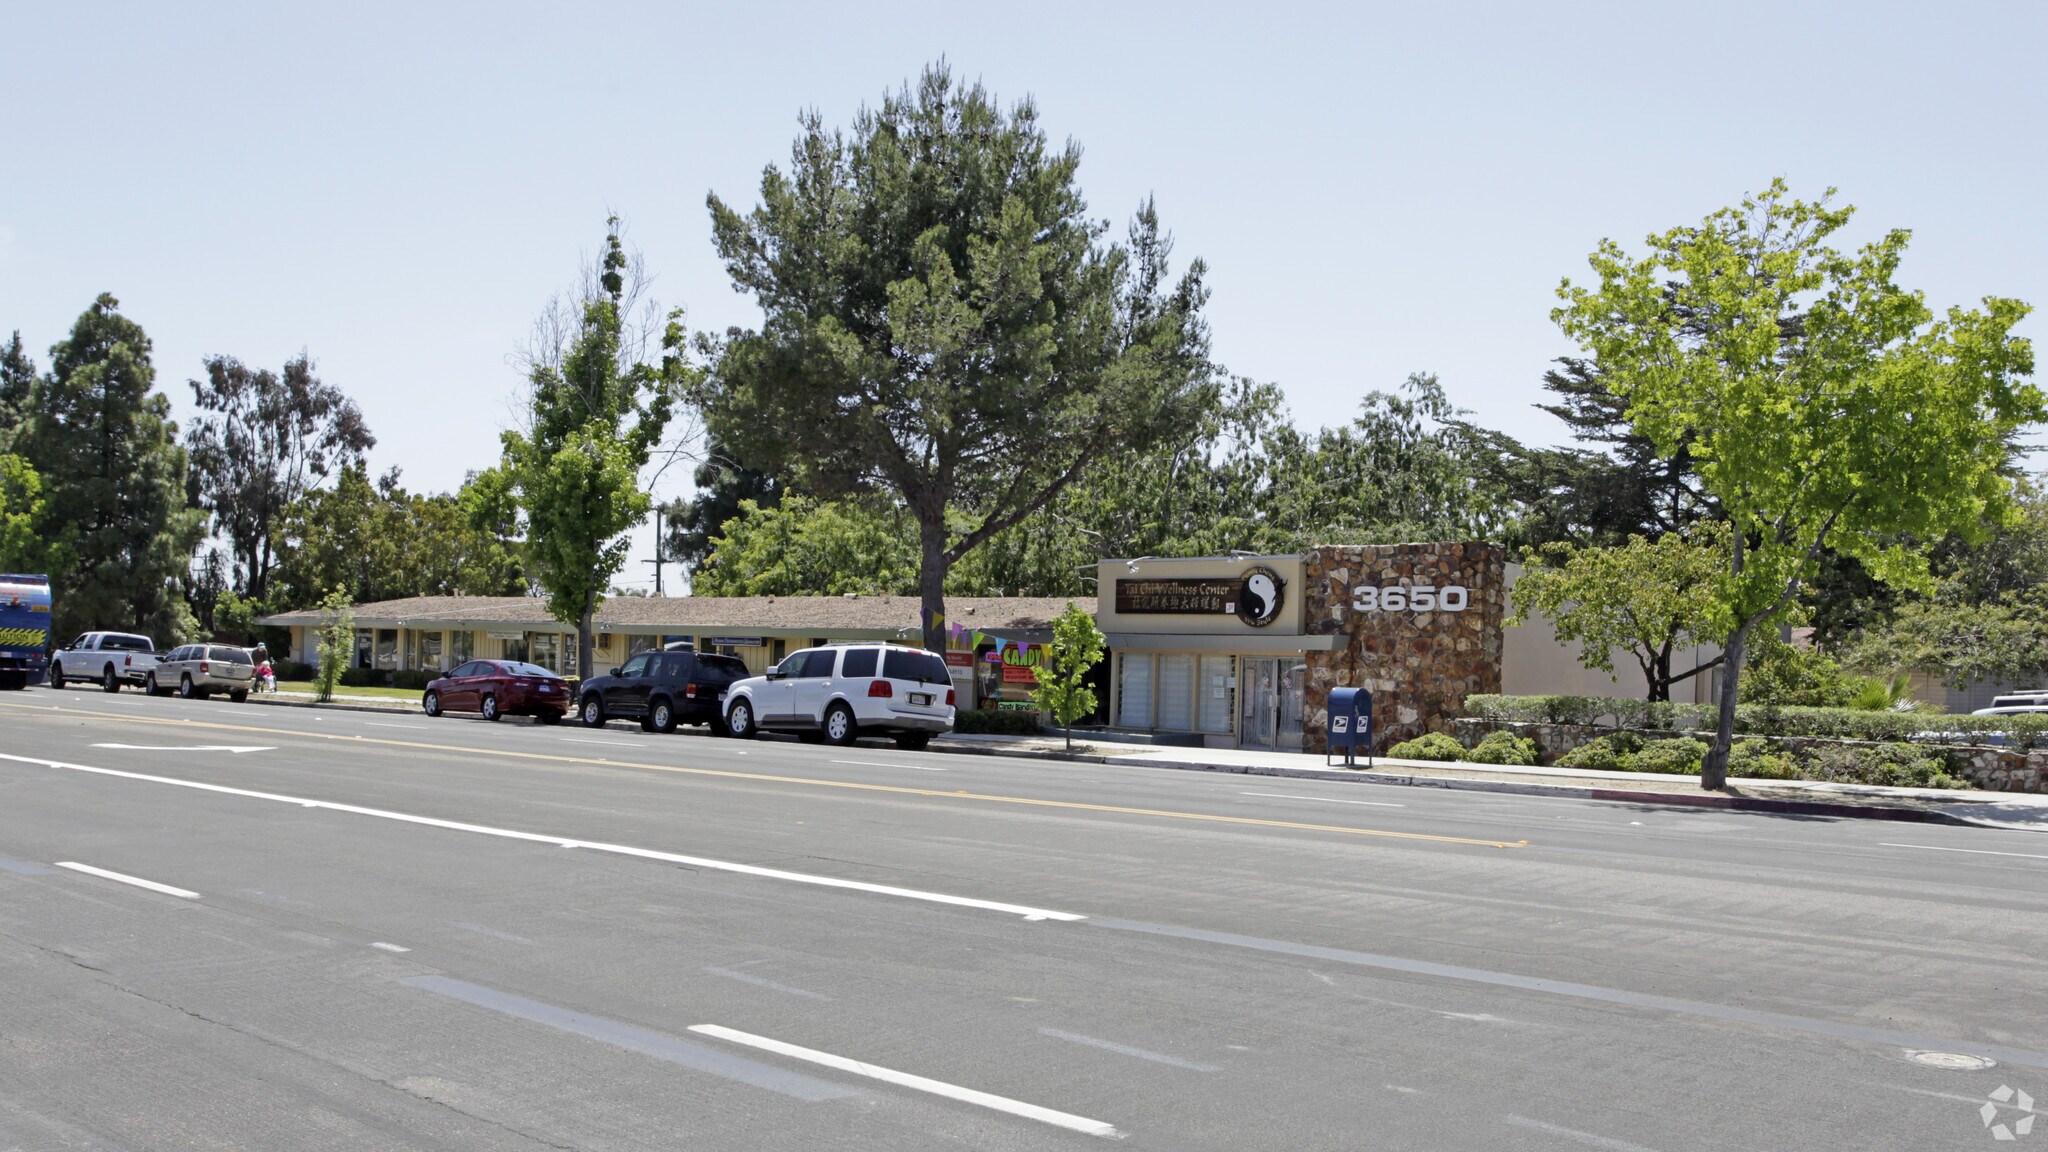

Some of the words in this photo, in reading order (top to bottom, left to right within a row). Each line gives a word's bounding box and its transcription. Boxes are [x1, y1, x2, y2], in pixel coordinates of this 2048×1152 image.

[1125, 583, 1138, 595] Tai
[1140, 582, 1154, 595] Chi
[1155, 582, 1197, 595] Wellness
[1199, 582, 1230, 595] Center
[1353, 585, 1468, 612] 3650
[1256, 616, 1272, 626] Style
[1003, 647, 1042, 667] CANDY
